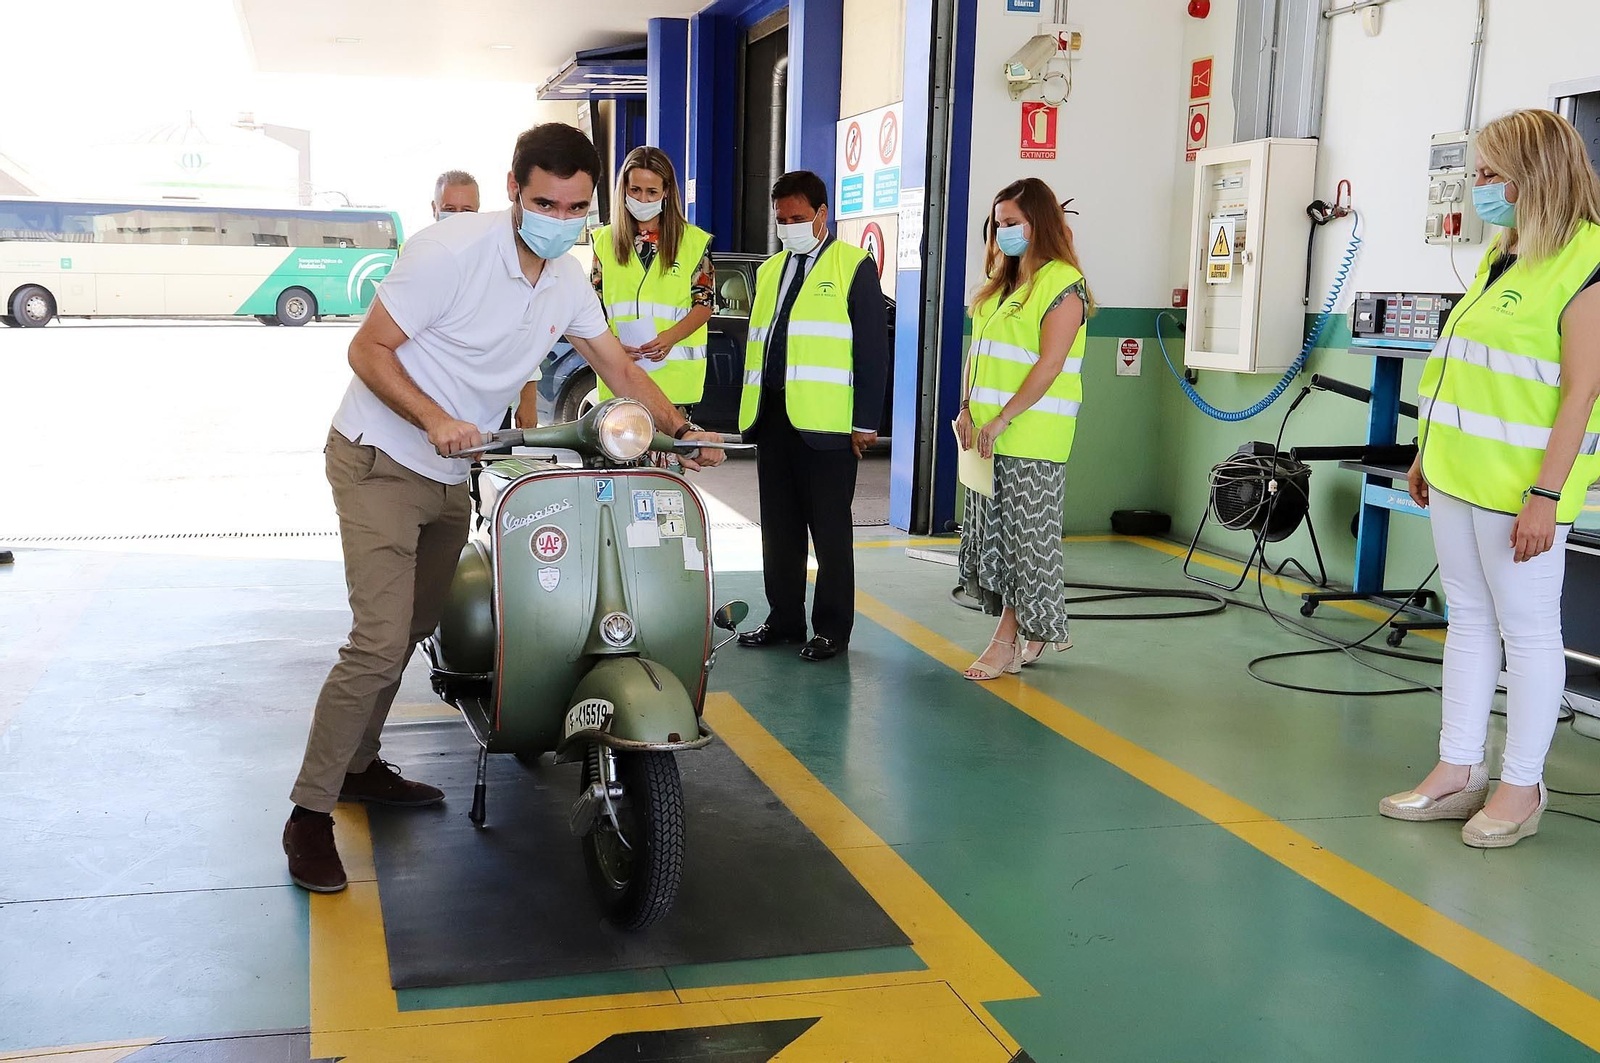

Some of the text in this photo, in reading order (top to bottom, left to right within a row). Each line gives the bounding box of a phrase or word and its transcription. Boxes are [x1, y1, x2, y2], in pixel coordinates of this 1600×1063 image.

[1021, 151, 1055, 159] EXTINTOR
[596, 480, 606, 493] P
[642, 499, 648, 512] 1
[669, 521, 675, 533] 1
